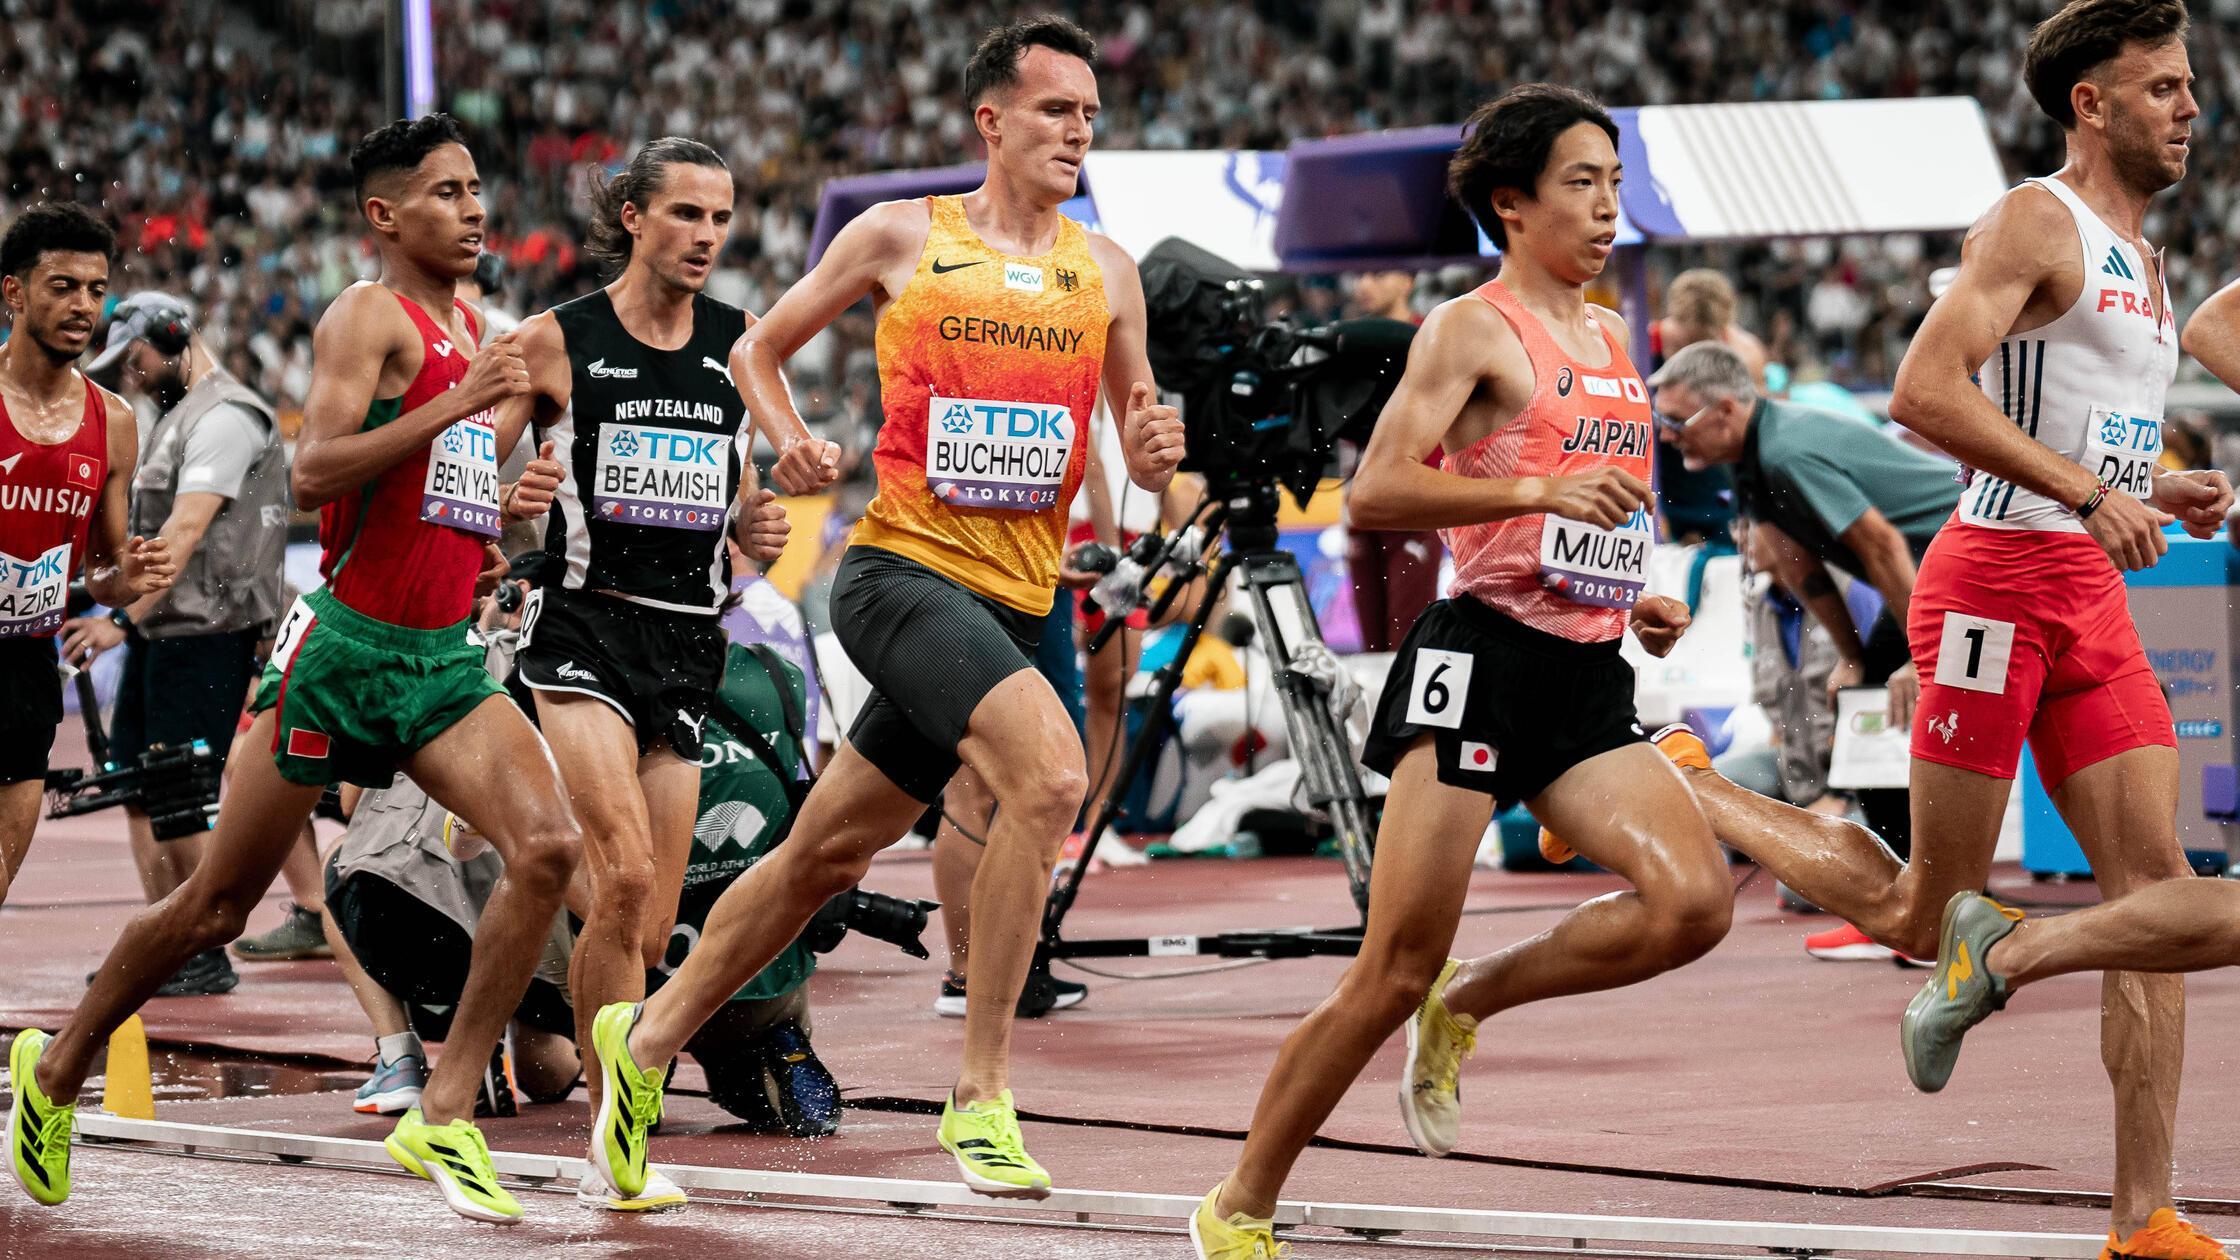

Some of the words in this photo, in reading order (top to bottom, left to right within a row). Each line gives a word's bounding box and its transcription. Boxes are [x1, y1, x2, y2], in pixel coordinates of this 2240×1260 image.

[1006, 269, 1041, 285] WGV
[938, 315, 1085, 355] GERMANY
[597, 367, 638, 375] ATHLETICS
[615, 399, 652, 421] NEW
[654, 398, 724, 425] ZEALAND
[974, 405, 1066, 441] TDK
[639, 431, 721, 466] TDK
[1562, 416, 1649, 459] JAPAN
[936, 441, 1067, 478] BUCHHOLZ
[432, 460, 468, 498] BEN
[604, 464, 721, 502] BEAMISH
[12, 550, 64, 589] TDK
[1553, 527, 1645, 575] MIURA
[0, 582, 61, 617] AZIRI
[277, 610, 300, 653] 5
[1965, 628, 1985, 679] 1
[1423, 662, 1452, 715] 6
